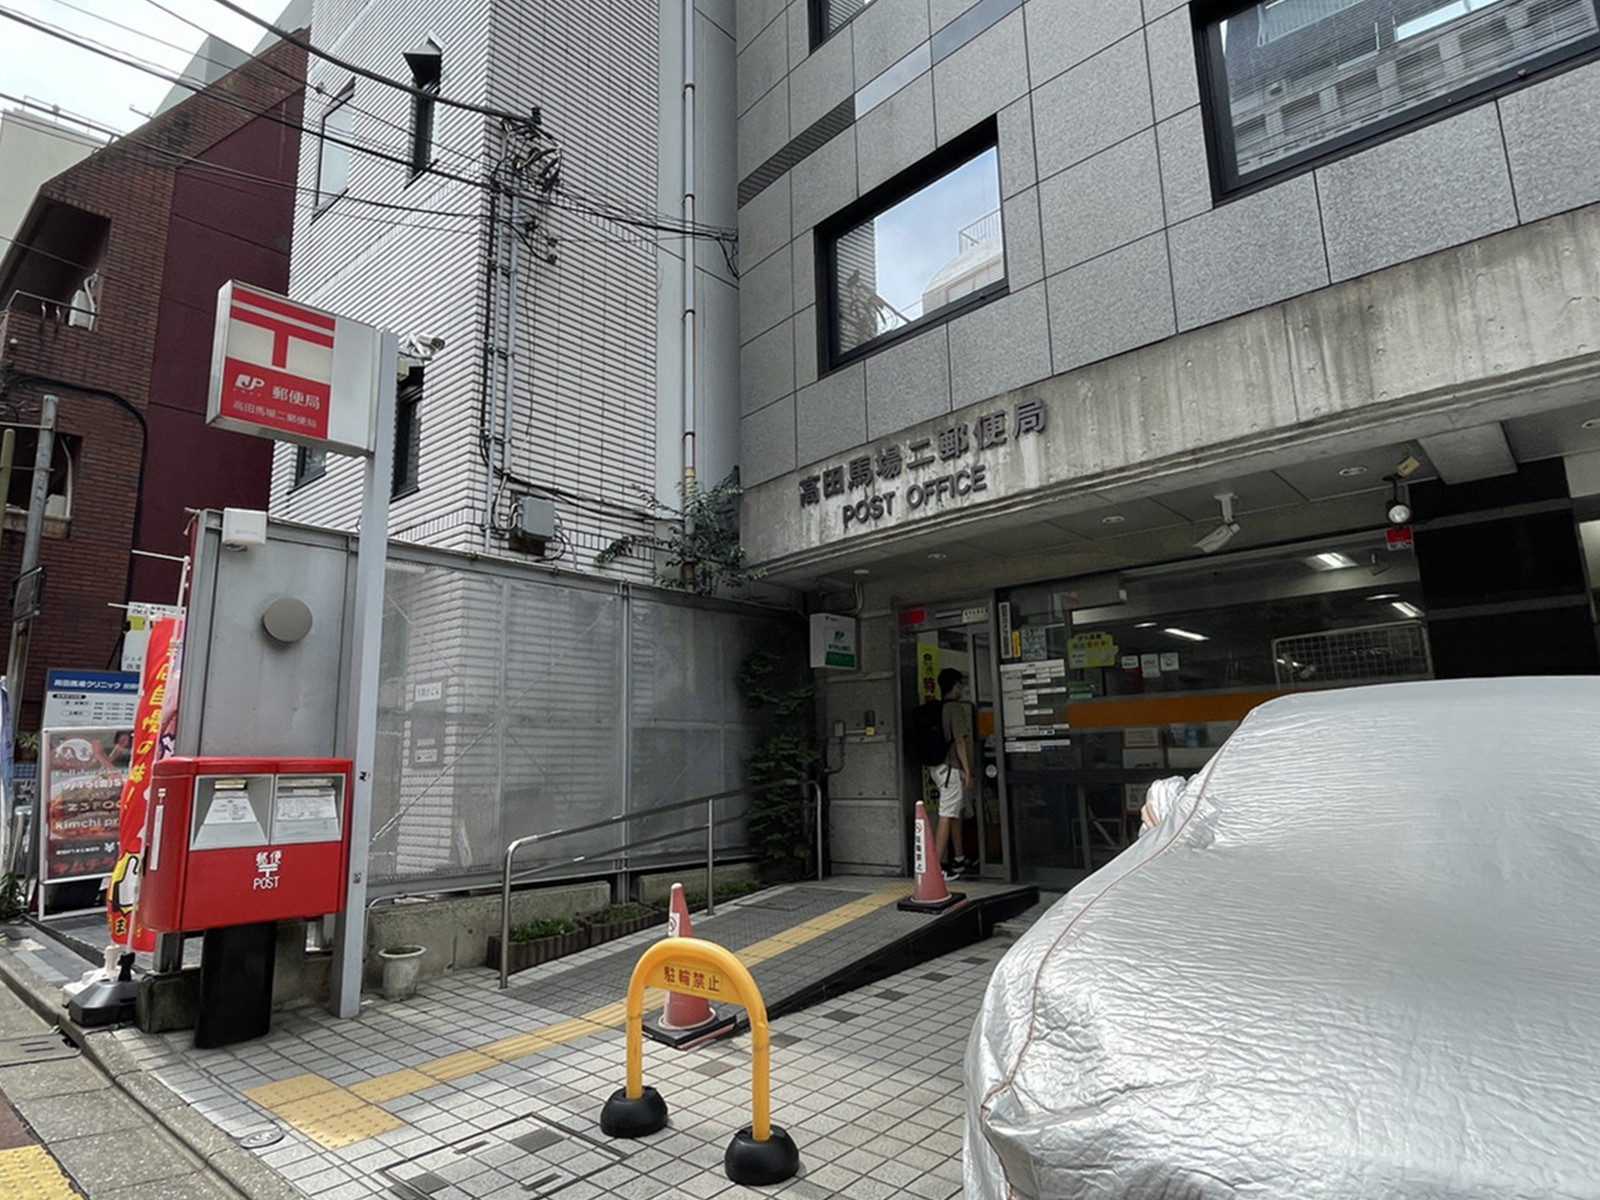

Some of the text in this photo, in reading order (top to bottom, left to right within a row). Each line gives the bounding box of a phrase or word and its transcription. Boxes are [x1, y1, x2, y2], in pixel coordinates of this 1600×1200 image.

[271, 385, 321, 410] 郵便局
[797, 398, 1048, 508] 高田馬場二郵便局
[842, 465, 988, 528] POST OFFICE
[252, 876, 280, 890] POST
[663, 966, 721, 992] 駐輪禁止
